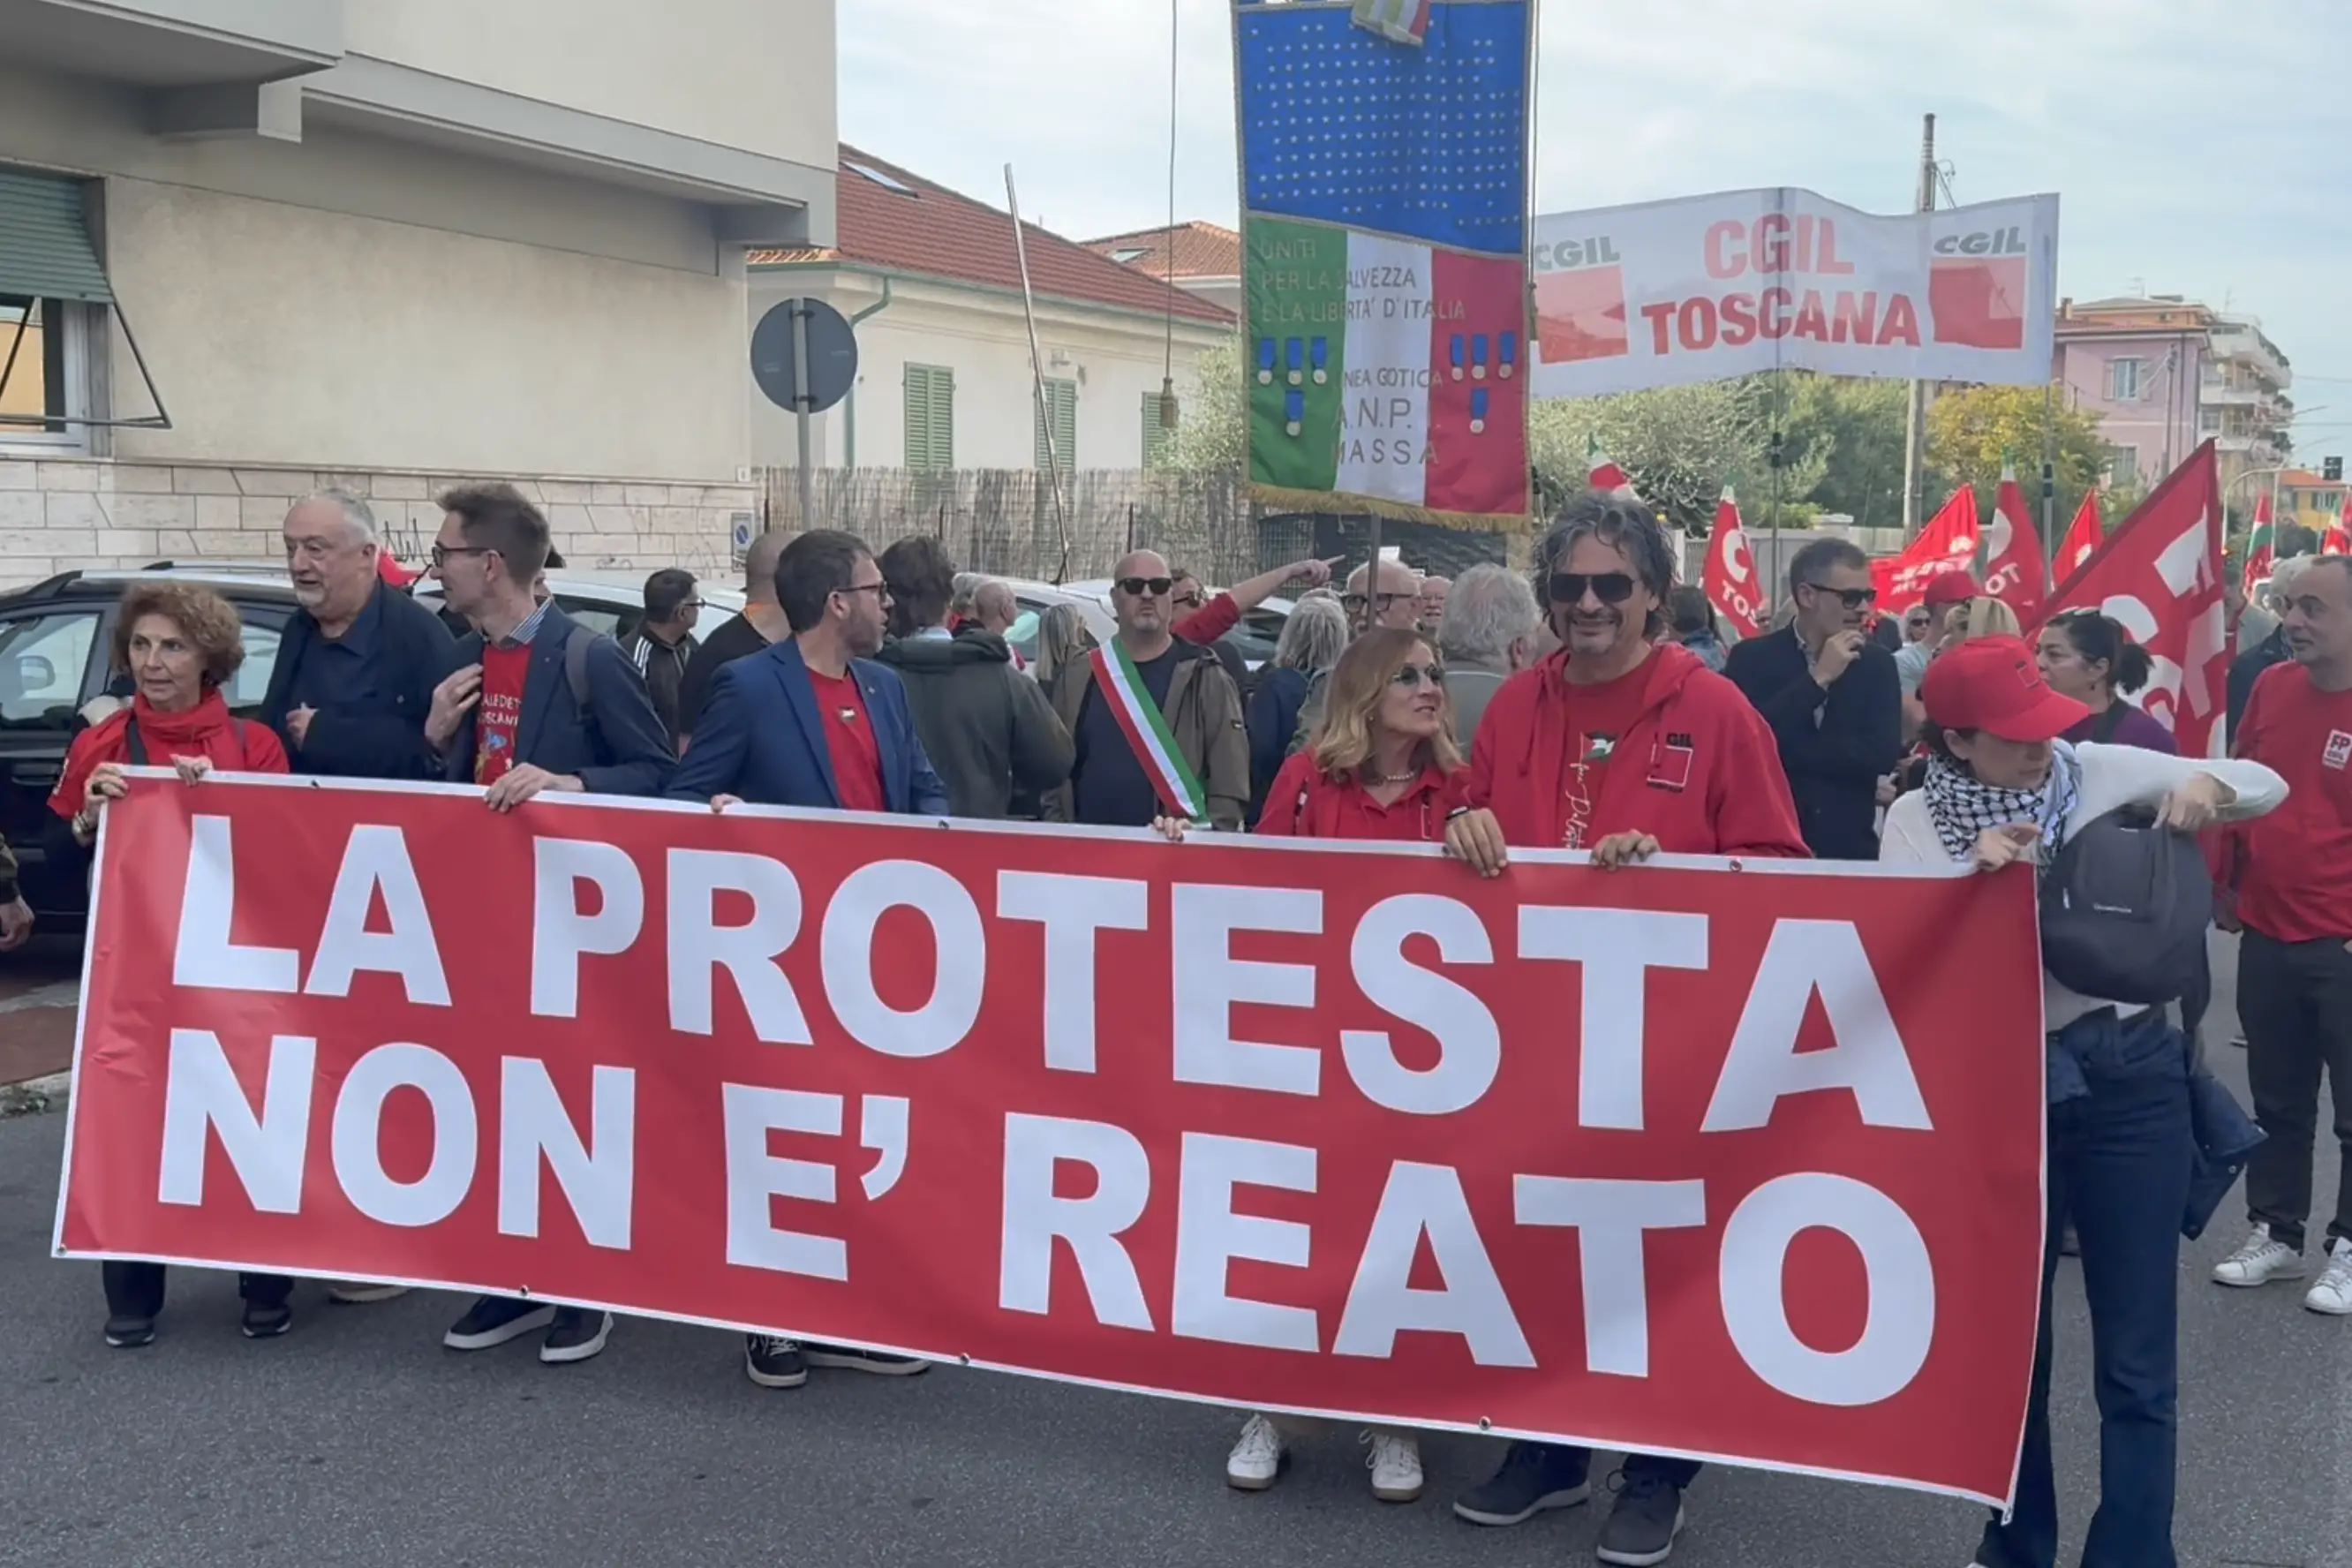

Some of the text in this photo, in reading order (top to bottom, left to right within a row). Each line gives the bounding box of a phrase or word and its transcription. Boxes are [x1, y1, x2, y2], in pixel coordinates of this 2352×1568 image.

[1534, 236, 1621, 270] CGIL
[1704, 213, 1855, 280] CGIL
[1934, 226, 2027, 254] CGIL
[1261, 270, 1300, 292] PER
[1306, 268, 1332, 291] LA
[1279, 301, 1306, 323] LA
[1641, 286, 1921, 356] TOSCANA
[1377, 367, 1444, 388] GOTICA
[171, 814, 1935, 1133] LA PROTESTA
[158, 1028, 1936, 1407] NON E' REATO
